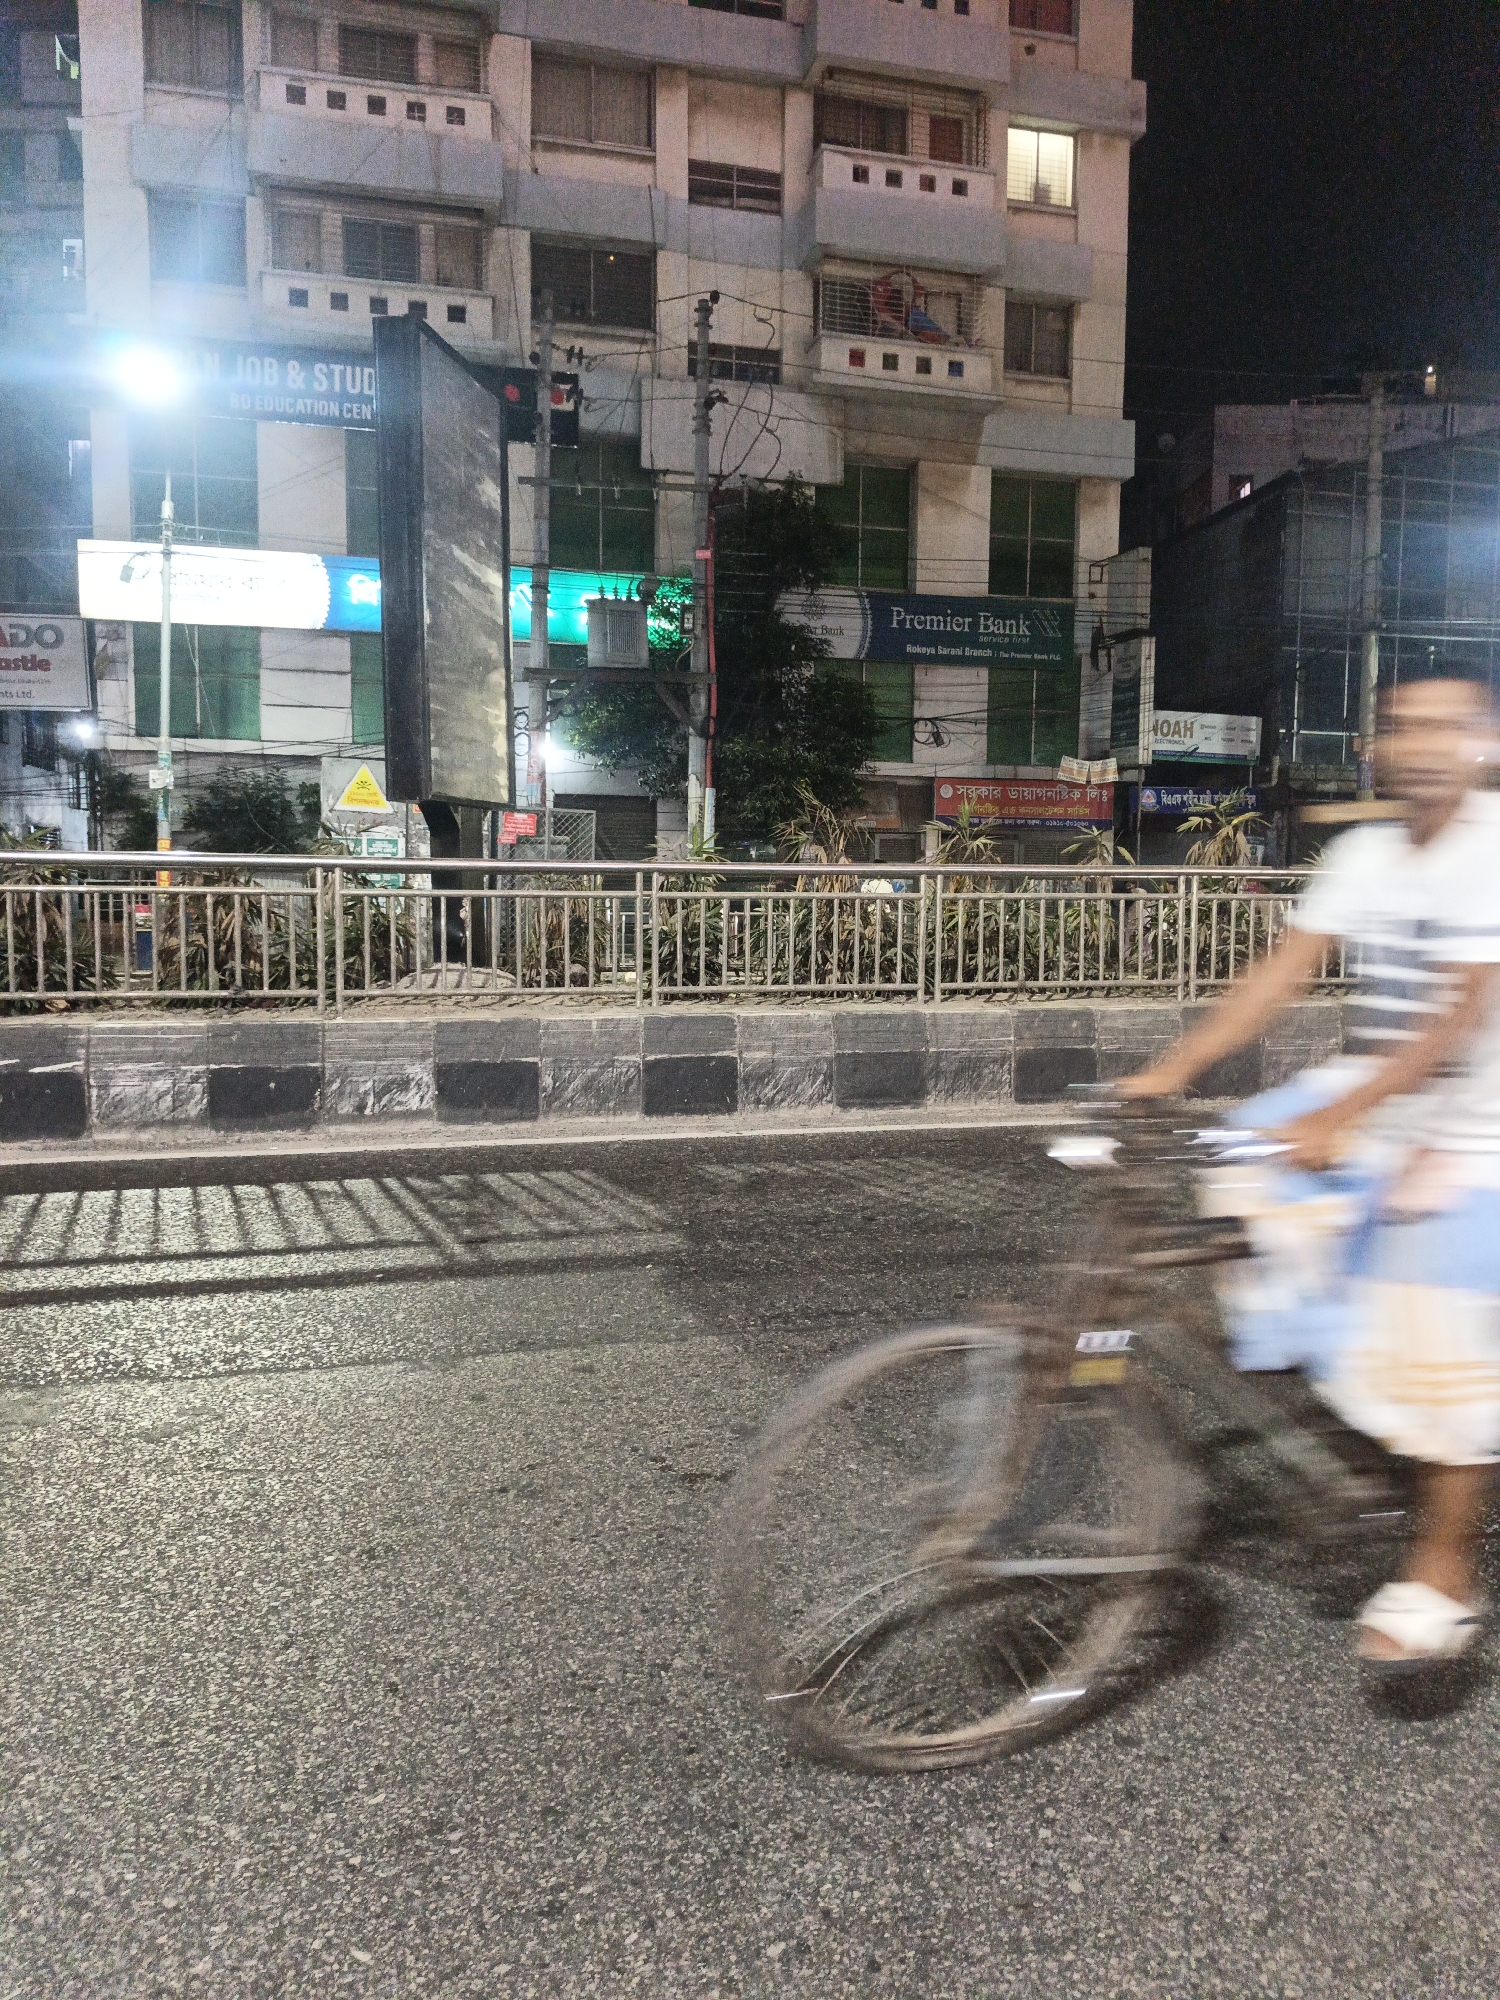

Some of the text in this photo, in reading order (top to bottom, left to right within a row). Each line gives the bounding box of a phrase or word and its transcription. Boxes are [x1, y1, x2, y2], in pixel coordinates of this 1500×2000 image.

[231, 354, 279, 387] JOB
[287, 360, 306, 389] &
[255, 395, 339, 418] EDUCATION
[890, 606, 1031, 635] Premier Bank
[821, 624, 845, 636] Bank
[978, 634, 1030, 644] service first
[906, 644, 936, 656] Rokeya
[938, 646, 963, 656] Sarani
[965, 647, 993, 658] Branch
[16, 690, 35, 699] Ltd.
[956, 783, 1002, 801] সরকার
